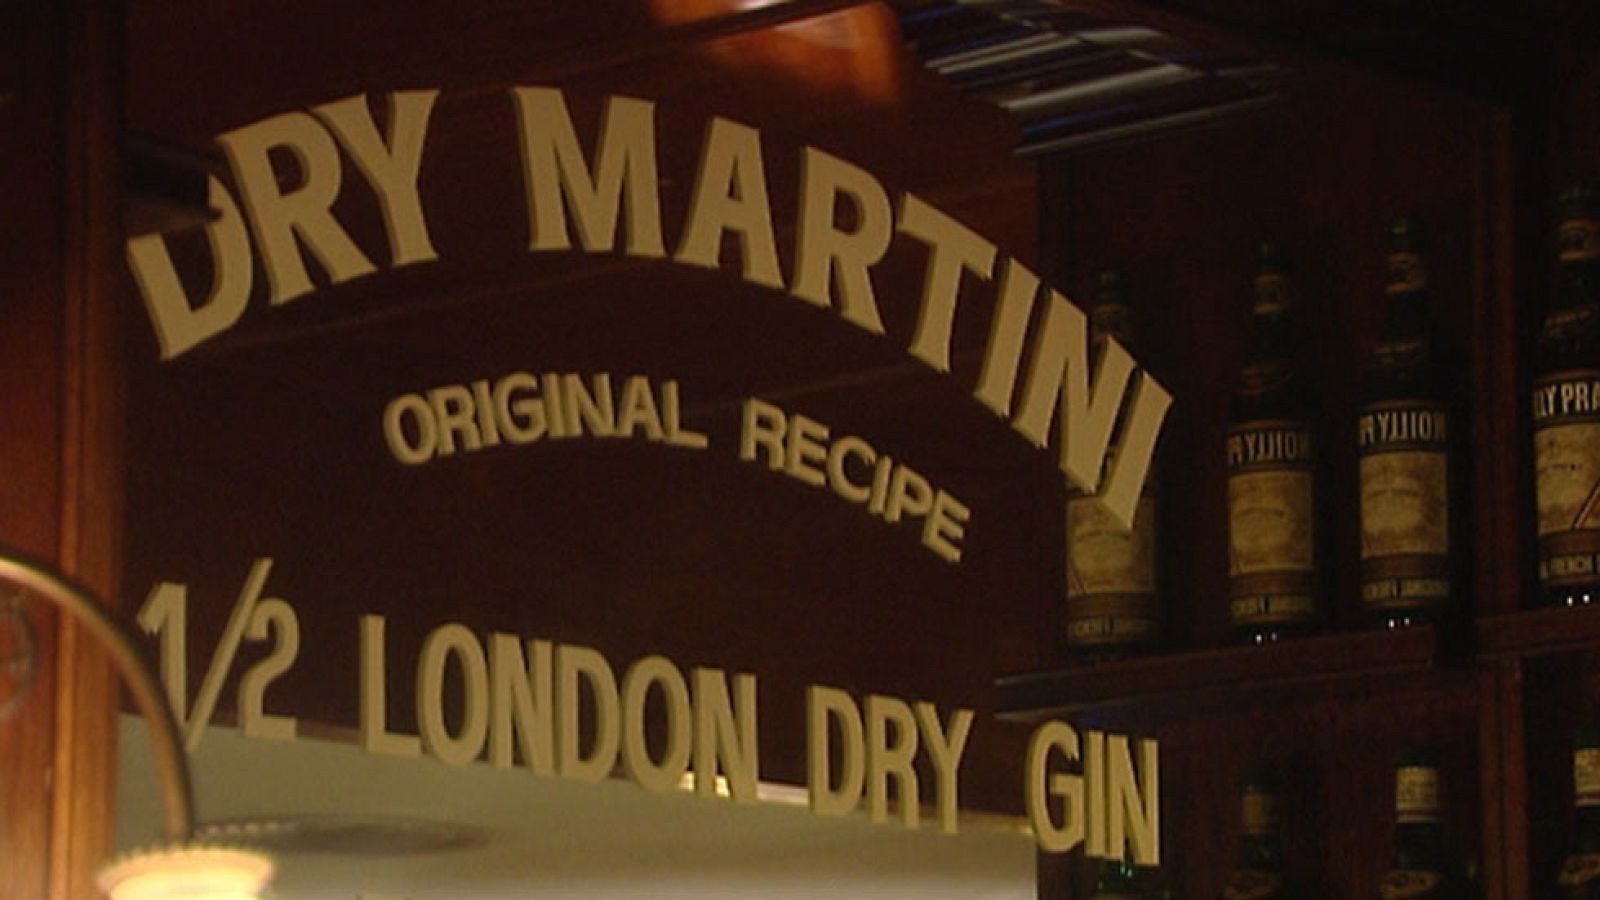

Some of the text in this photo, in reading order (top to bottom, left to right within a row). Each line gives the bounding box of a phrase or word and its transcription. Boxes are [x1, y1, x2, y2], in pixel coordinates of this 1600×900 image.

[126, 86, 1175, 530] DRY MARTINI
[383, 372, 971, 562] ORIGINAL RECIPE
[136, 557, 1160, 866] 1/2 LONDON DRY GIN
